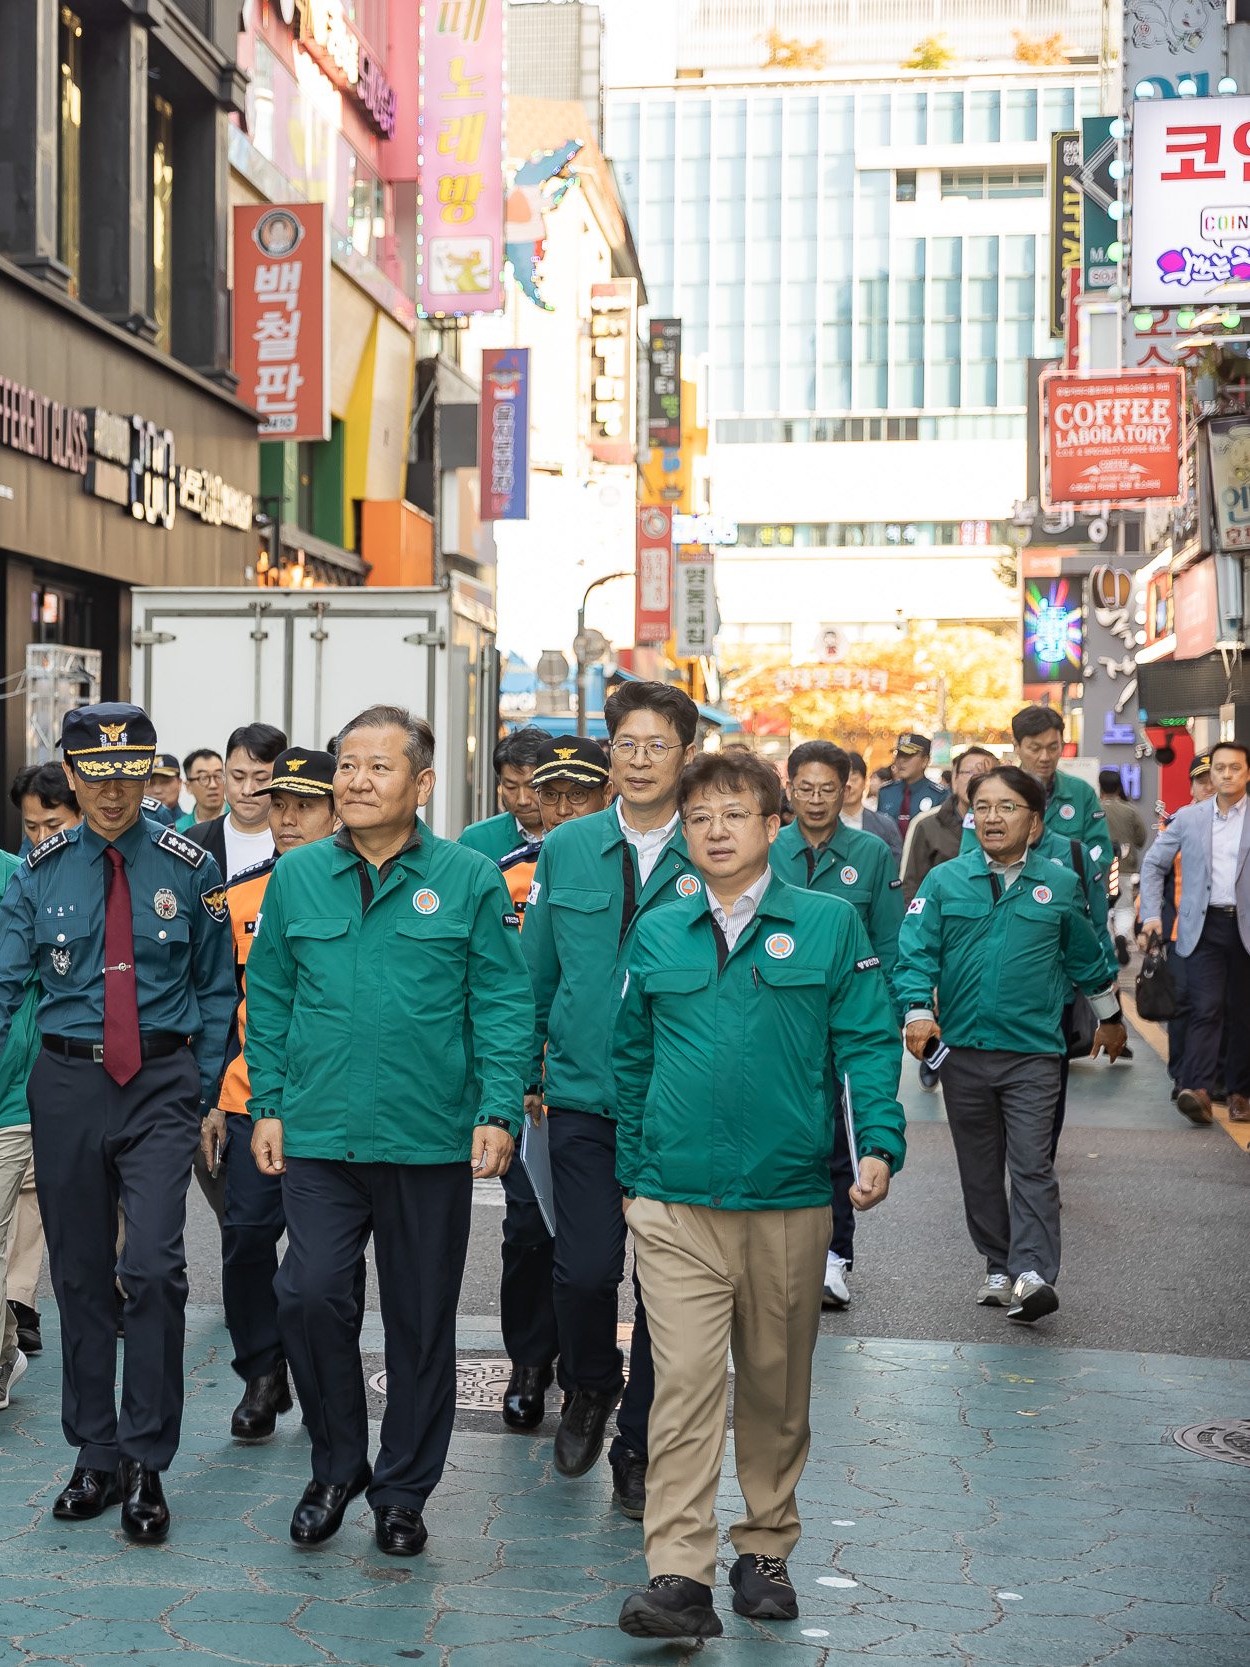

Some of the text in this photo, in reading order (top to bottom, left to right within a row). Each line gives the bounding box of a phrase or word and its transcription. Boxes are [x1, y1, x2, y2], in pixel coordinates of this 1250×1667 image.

[1205, 215, 1249, 231] COIN
[253, 261, 305, 413] 백철판
[1054, 398, 1172, 431] COFFEE
[1054, 423, 1173, 449] LABORATORY
